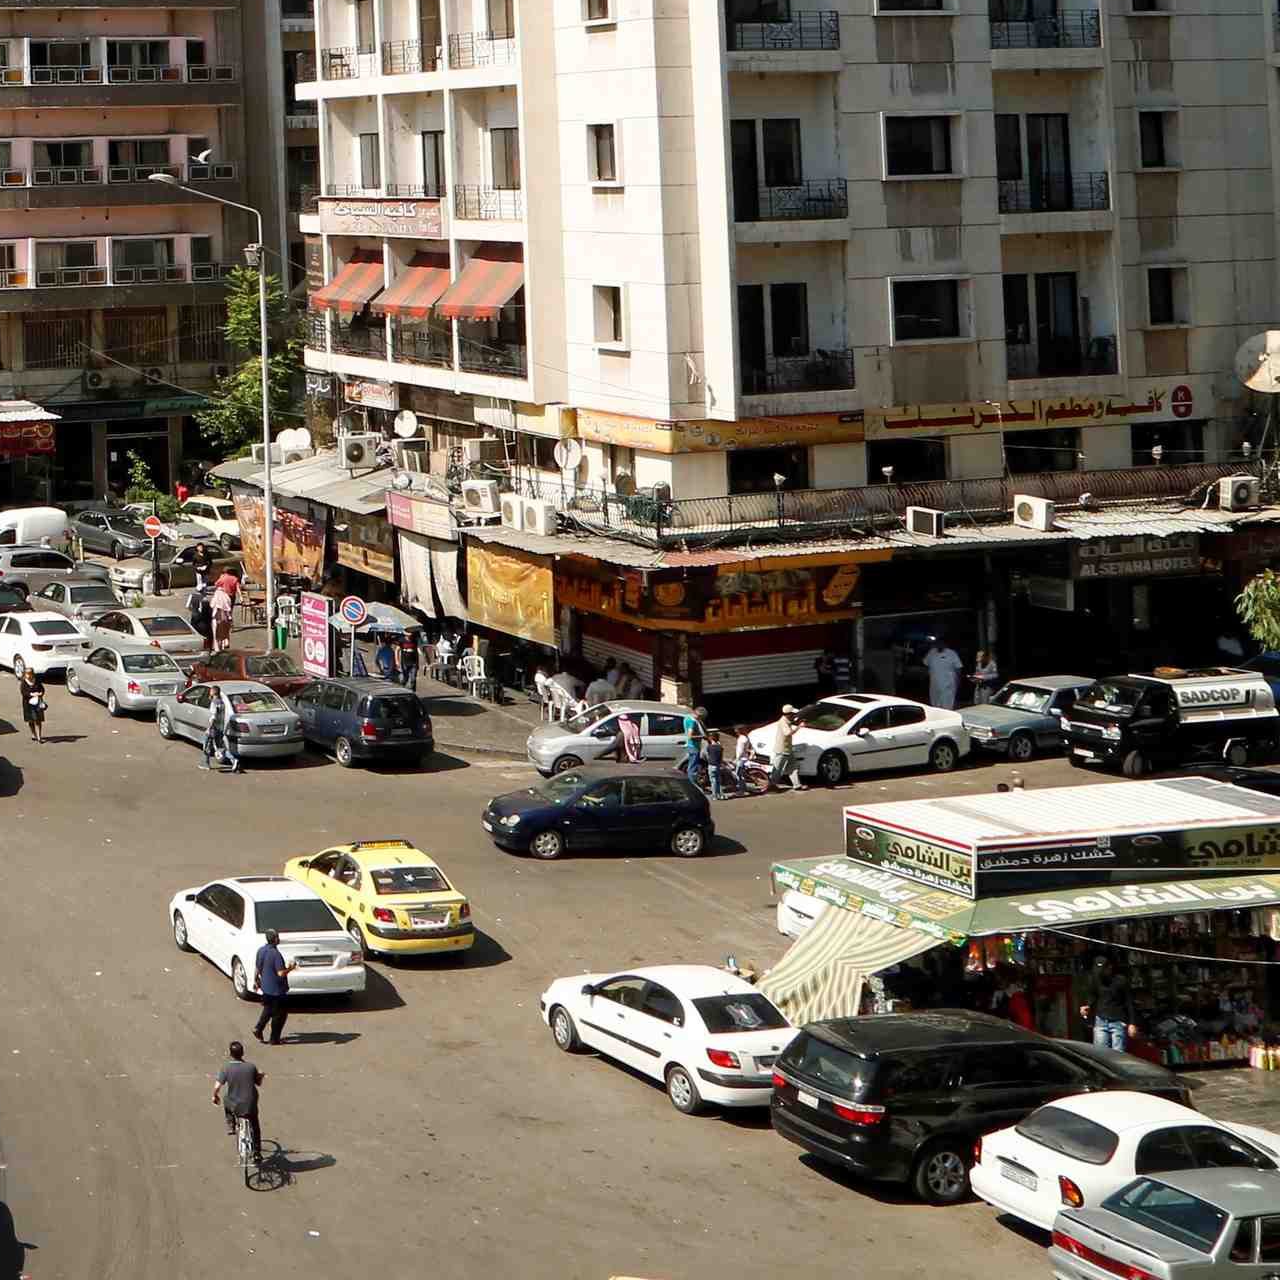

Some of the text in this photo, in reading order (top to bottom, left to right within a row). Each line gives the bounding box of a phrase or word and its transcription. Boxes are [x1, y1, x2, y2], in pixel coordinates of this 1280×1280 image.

[1045, 395, 1104, 424] ومطعم
[1104, 387, 1166, 416] كافيه
[1179, 687, 1241, 704] SADCOP
[887, 840, 972, 883] بن الشامي
[979, 847, 1117, 870] كشك زهرة دمشق
[880, 858, 972, 894] كشك زهرة دمشق
[1018, 883, 1212, 921] الشامي
[1214, 882, 1276, 902] بن
